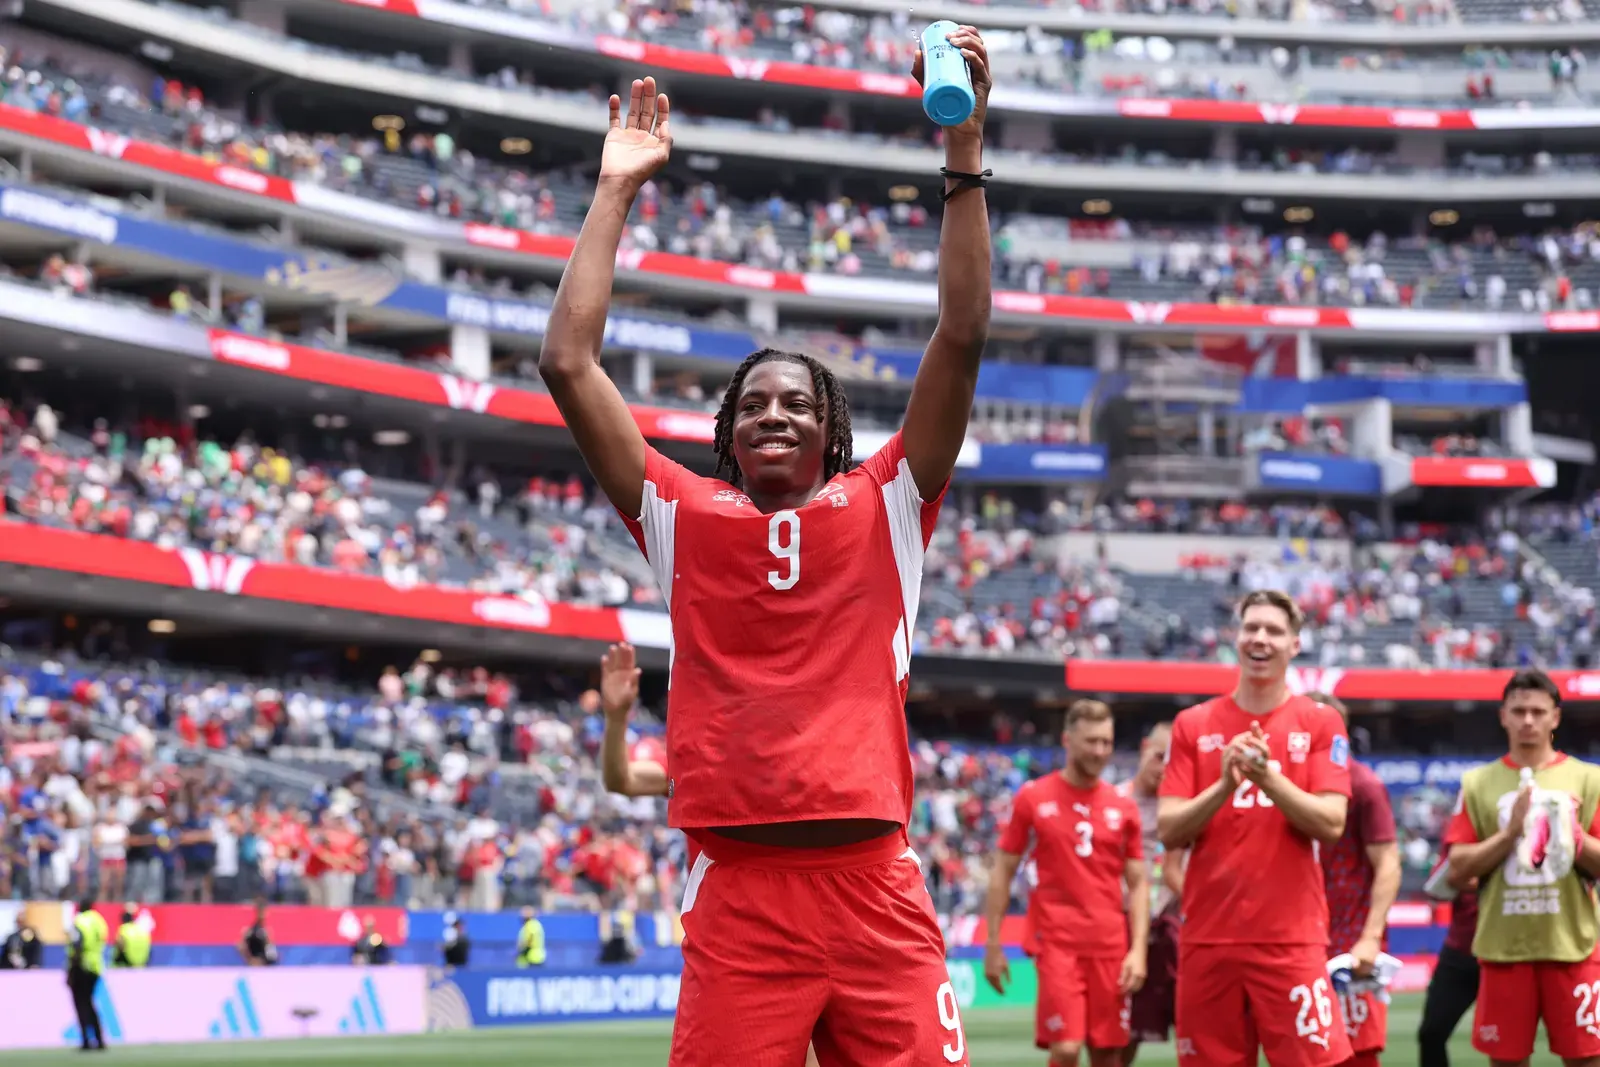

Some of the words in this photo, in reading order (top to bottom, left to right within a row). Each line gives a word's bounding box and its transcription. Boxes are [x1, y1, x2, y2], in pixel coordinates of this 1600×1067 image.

[767, 510, 800, 590] 9
[1074, 821, 1094, 857] 3
[486, 976, 538, 1017] FIFA
[538, 975, 615, 1015] WORLD
[616, 974, 656, 1013] CUP
[936, 981, 965, 1063] 9
[1289, 977, 1332, 1036] 26
